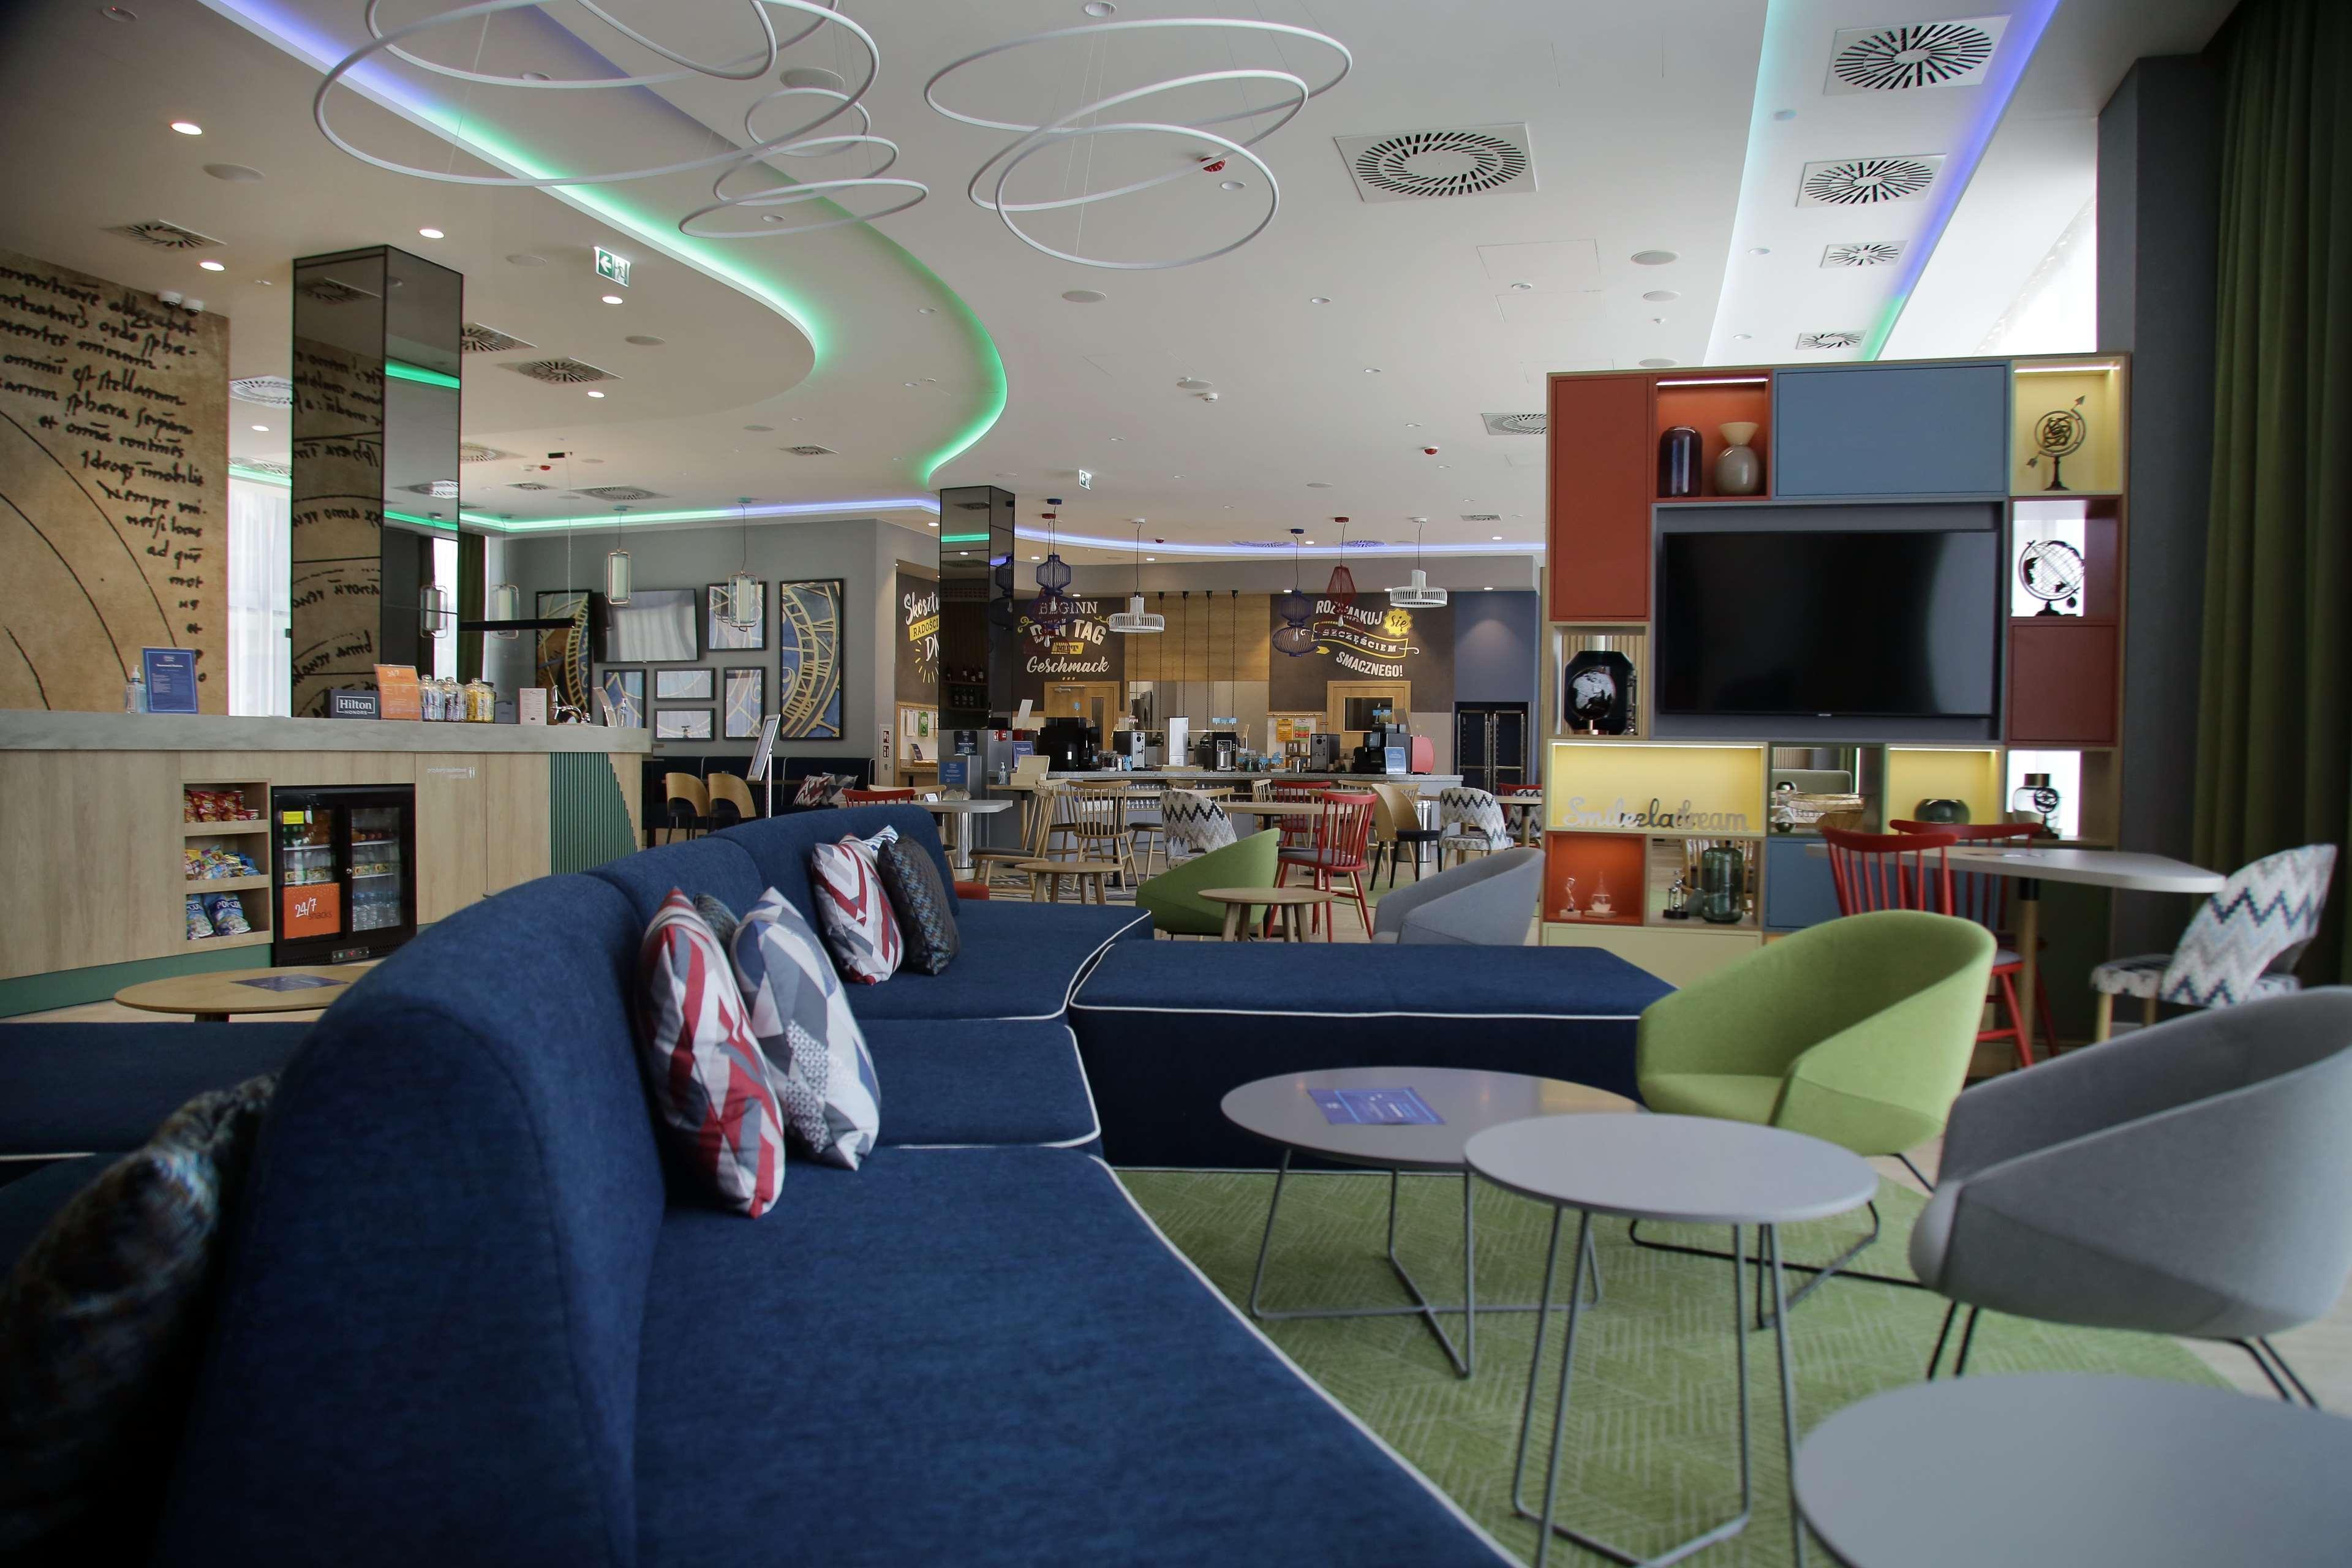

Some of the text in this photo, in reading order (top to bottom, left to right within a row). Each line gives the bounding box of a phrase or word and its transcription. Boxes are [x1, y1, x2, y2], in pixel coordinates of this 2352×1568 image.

[903, 591, 940, 625] Skosztu
[1316, 600, 1383, 626] ROZMAKUJ
[1073, 619, 1107, 646] TAG
[1026, 655, 1110, 673] Geschmack
[1335, 651, 1403, 677] SMACZNEGO!
[339, 699, 372, 710] Hilton
[1562, 795, 1749, 831] Smile rela dream
[295, 897, 317, 918] 24/7
